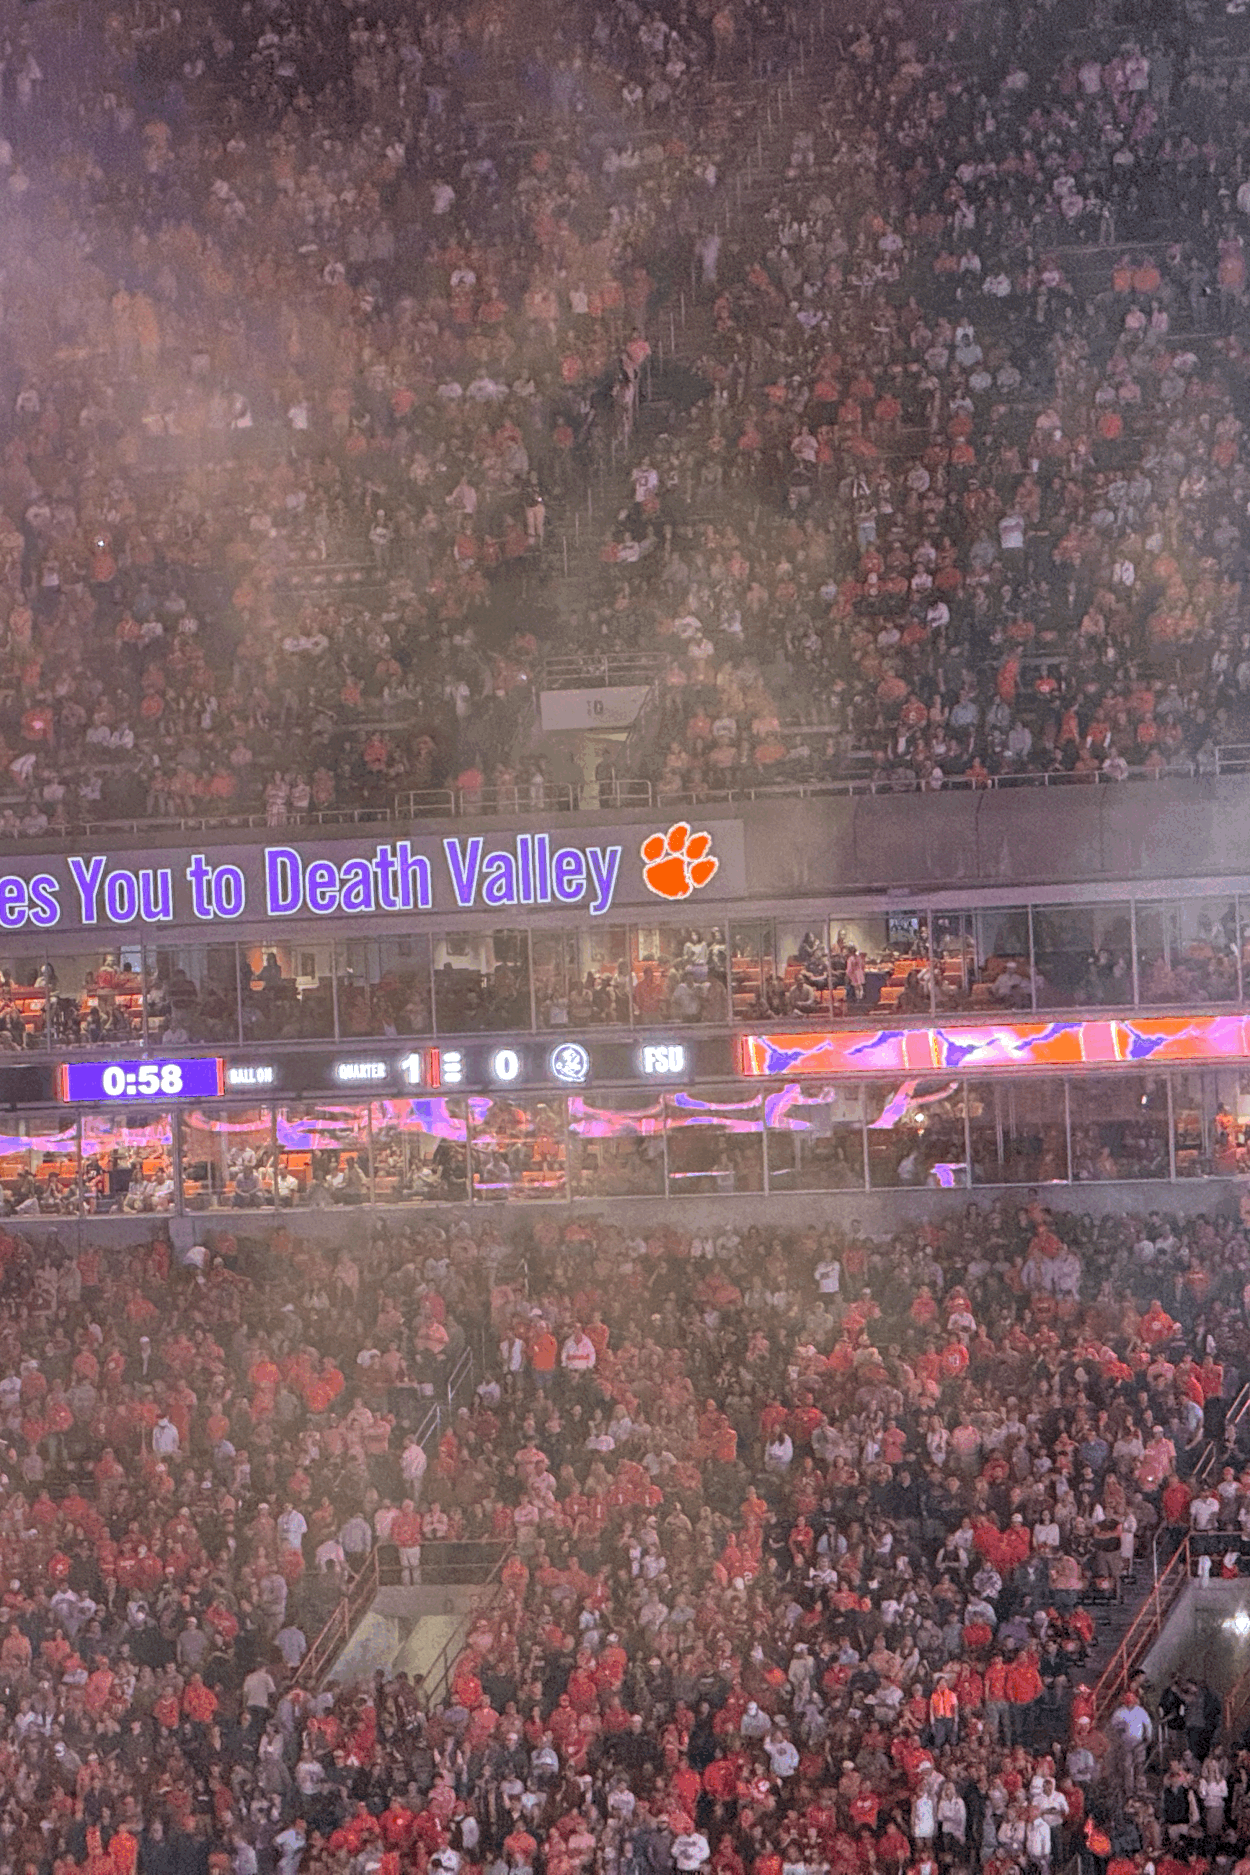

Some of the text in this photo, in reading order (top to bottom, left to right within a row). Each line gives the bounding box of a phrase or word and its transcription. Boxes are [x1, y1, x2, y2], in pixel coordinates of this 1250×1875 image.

[69, 856, 172, 924] You
[186, 854, 246, 919] to
[265, 840, 432, 916] Death
[443, 833, 622, 916] Valley
[338, 1053, 420, 1084] QUARTER 1
[494, 1049, 519, 1081] 0
[643, 1044, 685, 1074] FSU
[102, 1064, 183, 1096] 0:58
[230, 1066, 273, 1084] BALL ON
